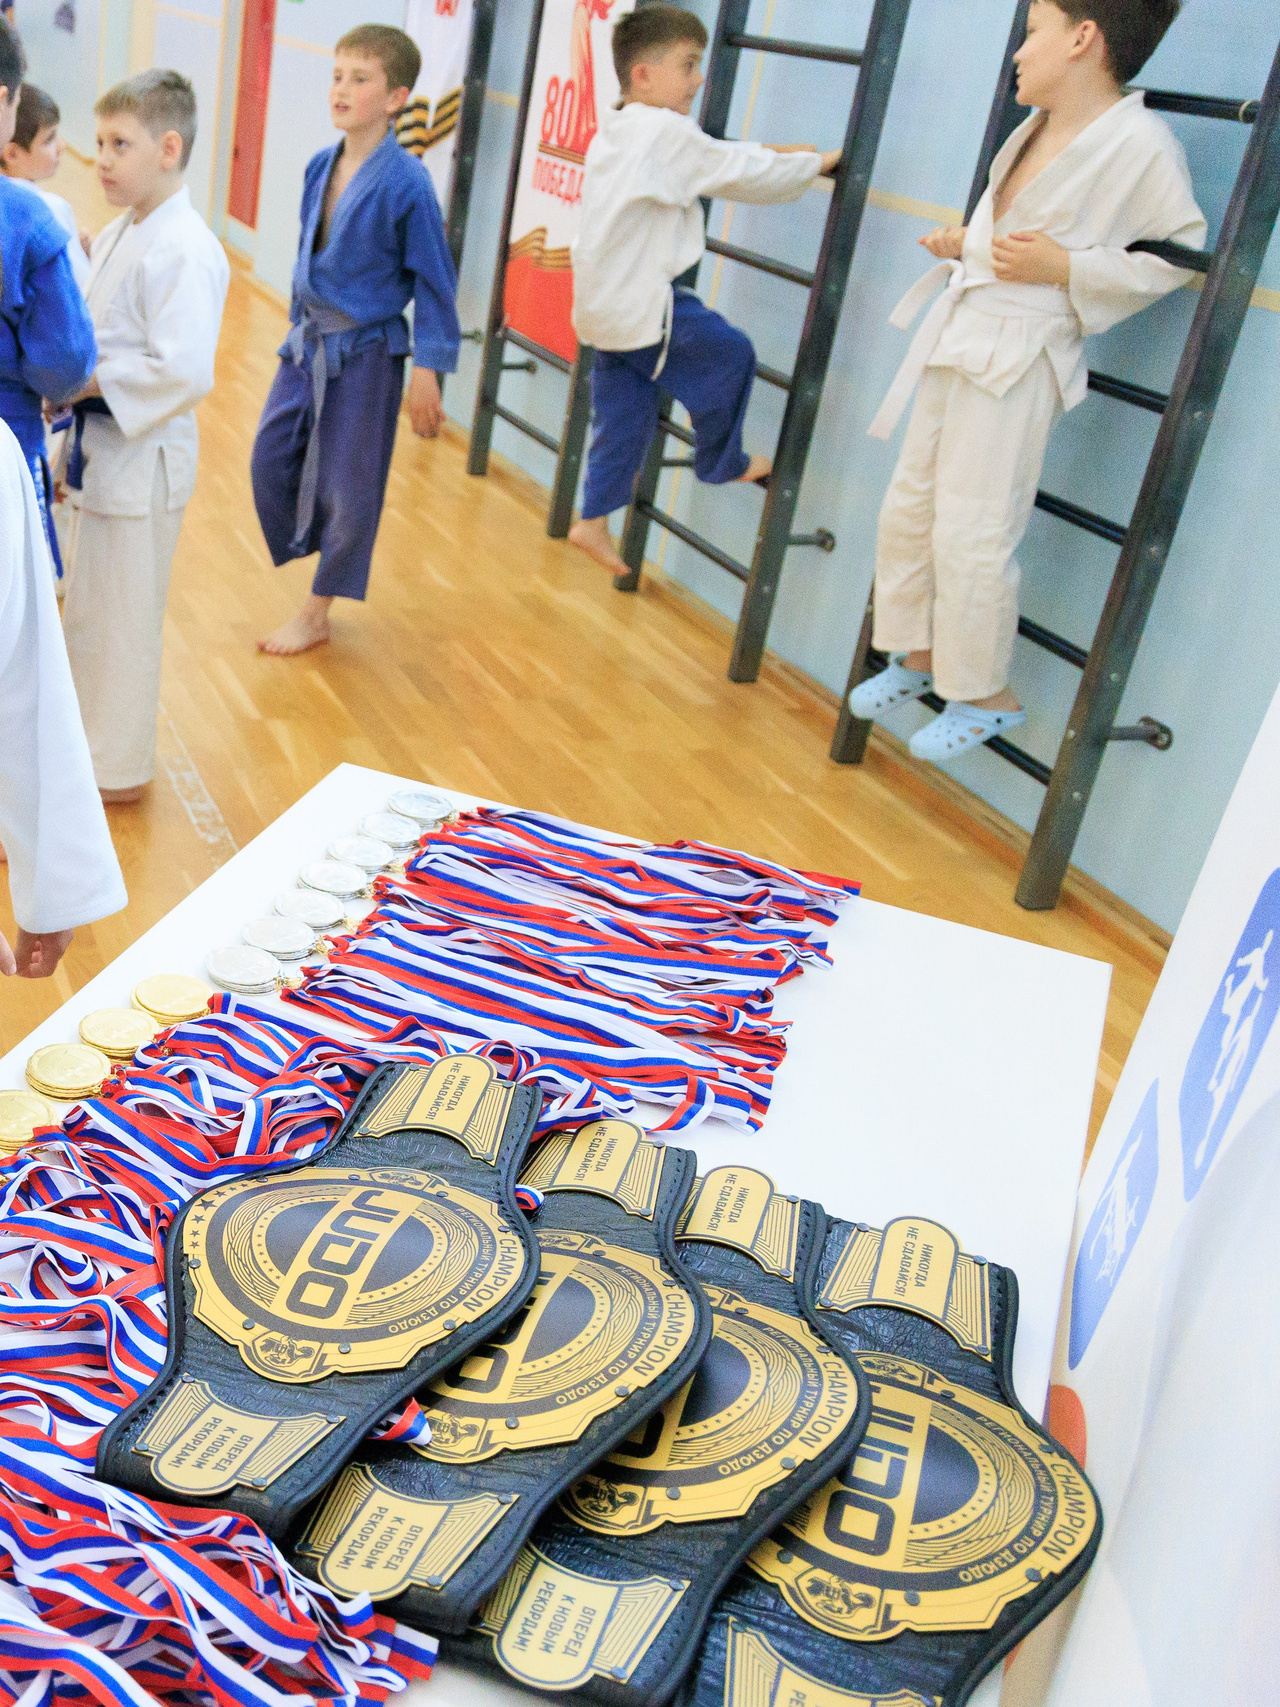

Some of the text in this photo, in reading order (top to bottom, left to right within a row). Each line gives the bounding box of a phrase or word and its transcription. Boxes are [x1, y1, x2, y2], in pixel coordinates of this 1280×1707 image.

[541, 75, 575, 147] 80
[425, 1062, 462, 1120] НЕ СДАВАЙСЯ!
[445, 1075, 471, 1111] НИКОГДА
[574, 1126, 608, 1181] НЕ СДАВАЙСЯ!
[594, 1138, 618, 1172] НИКОГДА
[707, 1173, 738, 1231] НЕ СДАВАЙСЯ!
[727, 1187, 750, 1223] НИКОГДА
[285, 1189, 401, 1320] JUDO
[388, 1208, 496, 1334] РЕГИОНАЛЬНЫЙ ТУРНИР ПО ДЗЮДО
[462, 1238, 518, 1313] CHAMPION
[894, 1226, 919, 1297] НЕ СДАВАЙСЯ!
[914, 1243, 934, 1287] НИКОГДА
[556, 1266, 661, 1405] РЕГИОНАЛЬНЫЙ ТУРНИР ПО ДЗЮДО
[633, 1293, 687, 1377] CHAMPION
[718, 1326, 819, 1476] РЕГИОНАЛЬНЫЙ ТУРНИР ПО ДЗЮДО
[799, 1361, 849, 1449] CHAMPION
[168, 1416, 223, 1468] РЕКОРДАМ!
[191, 1426, 238, 1469] К НОВЫМ
[212, 1434, 254, 1472] ВПЕРЕД
[959, 1415, 1055, 1583] РЕГИОНАЛЬНЫЙ ТУРНИР ПО ДЗЮДО
[1043, 1462, 1087, 1562] CHAMPION
[336, 1506, 389, 1570] РЕКОРДАМ!
[361, 1516, 406, 1569] К НОВЫМ
[383, 1525, 424, 1571] ВПЕРЕД
[512, 1580, 557, 1652] РЕКОРДАМ!
[538, 1594, 576, 1654] К НОВЫМ
[562, 1606, 597, 1658] ВПЕРЕД
